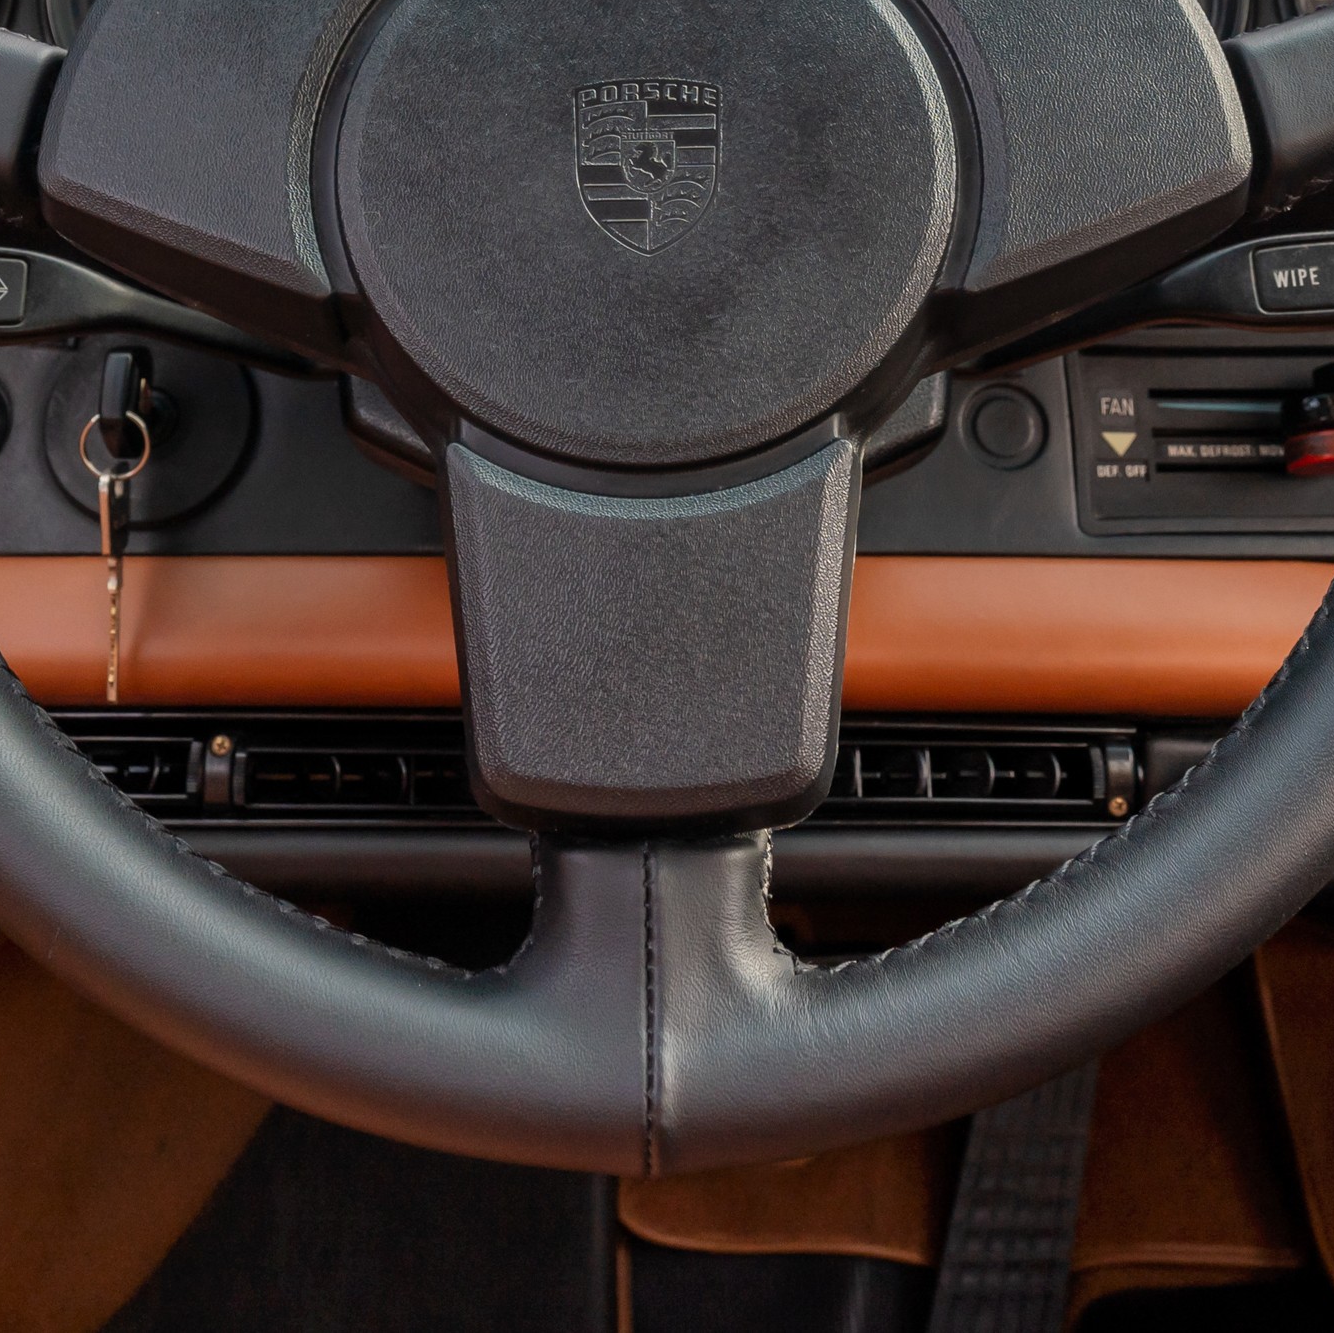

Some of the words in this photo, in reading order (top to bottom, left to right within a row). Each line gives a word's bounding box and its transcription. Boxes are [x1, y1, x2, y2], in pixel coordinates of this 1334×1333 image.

[581, 82, 718, 107] PORSCHE
[1273, 266, 1320, 289] WIPE
[1100, 396, 1135, 416] FAN
[1124, 464, 1147, 478] OFF
